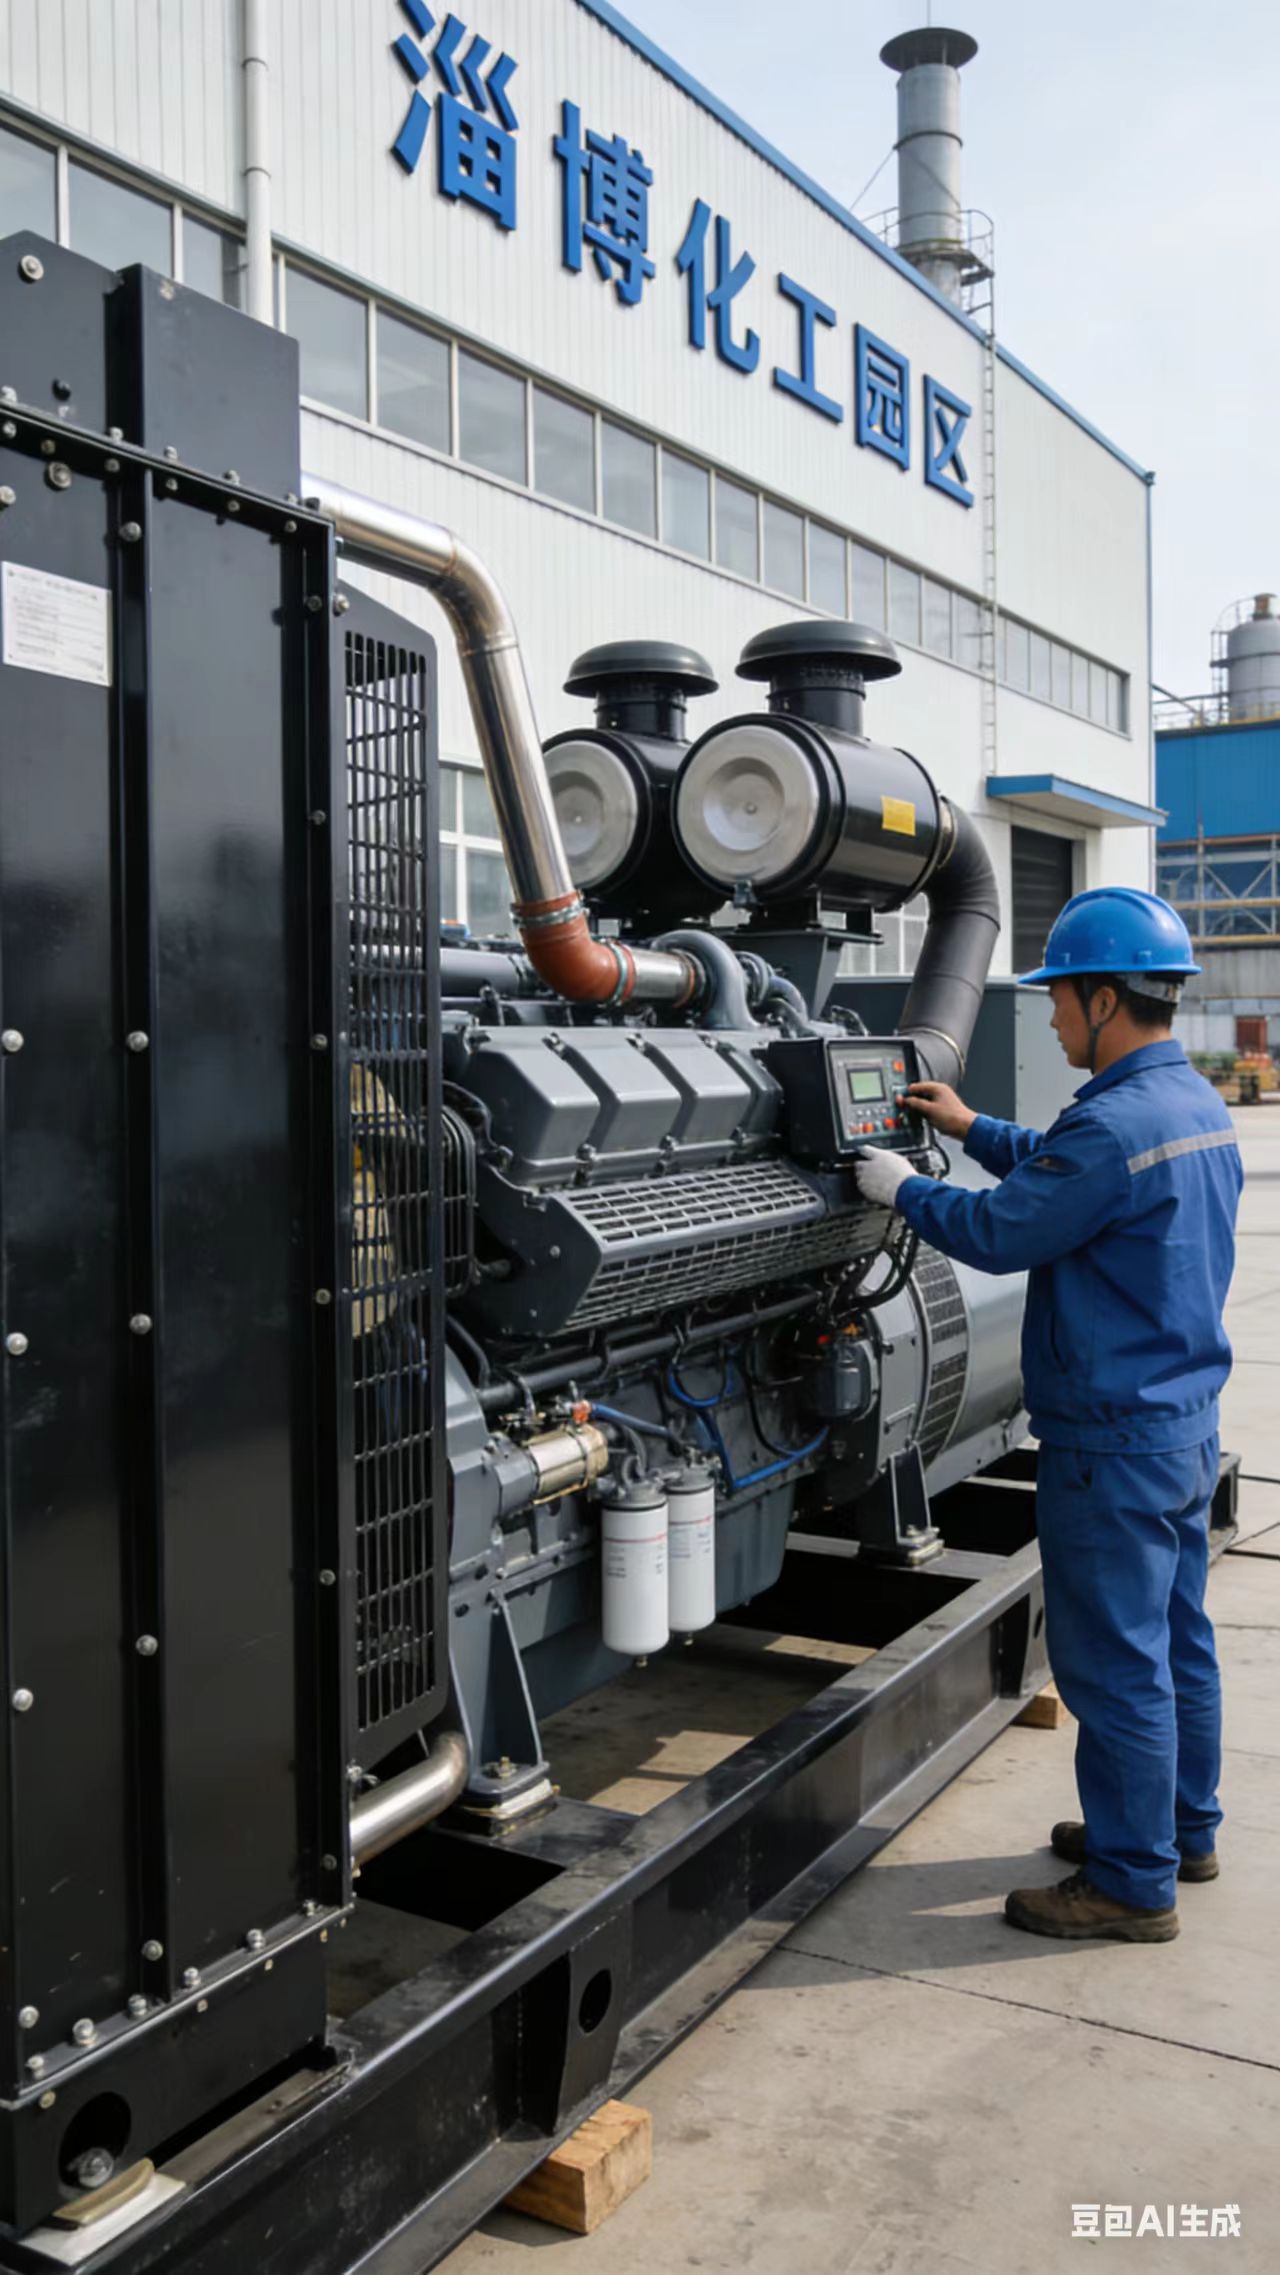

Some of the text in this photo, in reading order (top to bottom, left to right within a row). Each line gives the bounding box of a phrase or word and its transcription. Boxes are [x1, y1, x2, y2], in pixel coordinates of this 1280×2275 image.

[391, 0, 974, 508] 淄博化工园区
